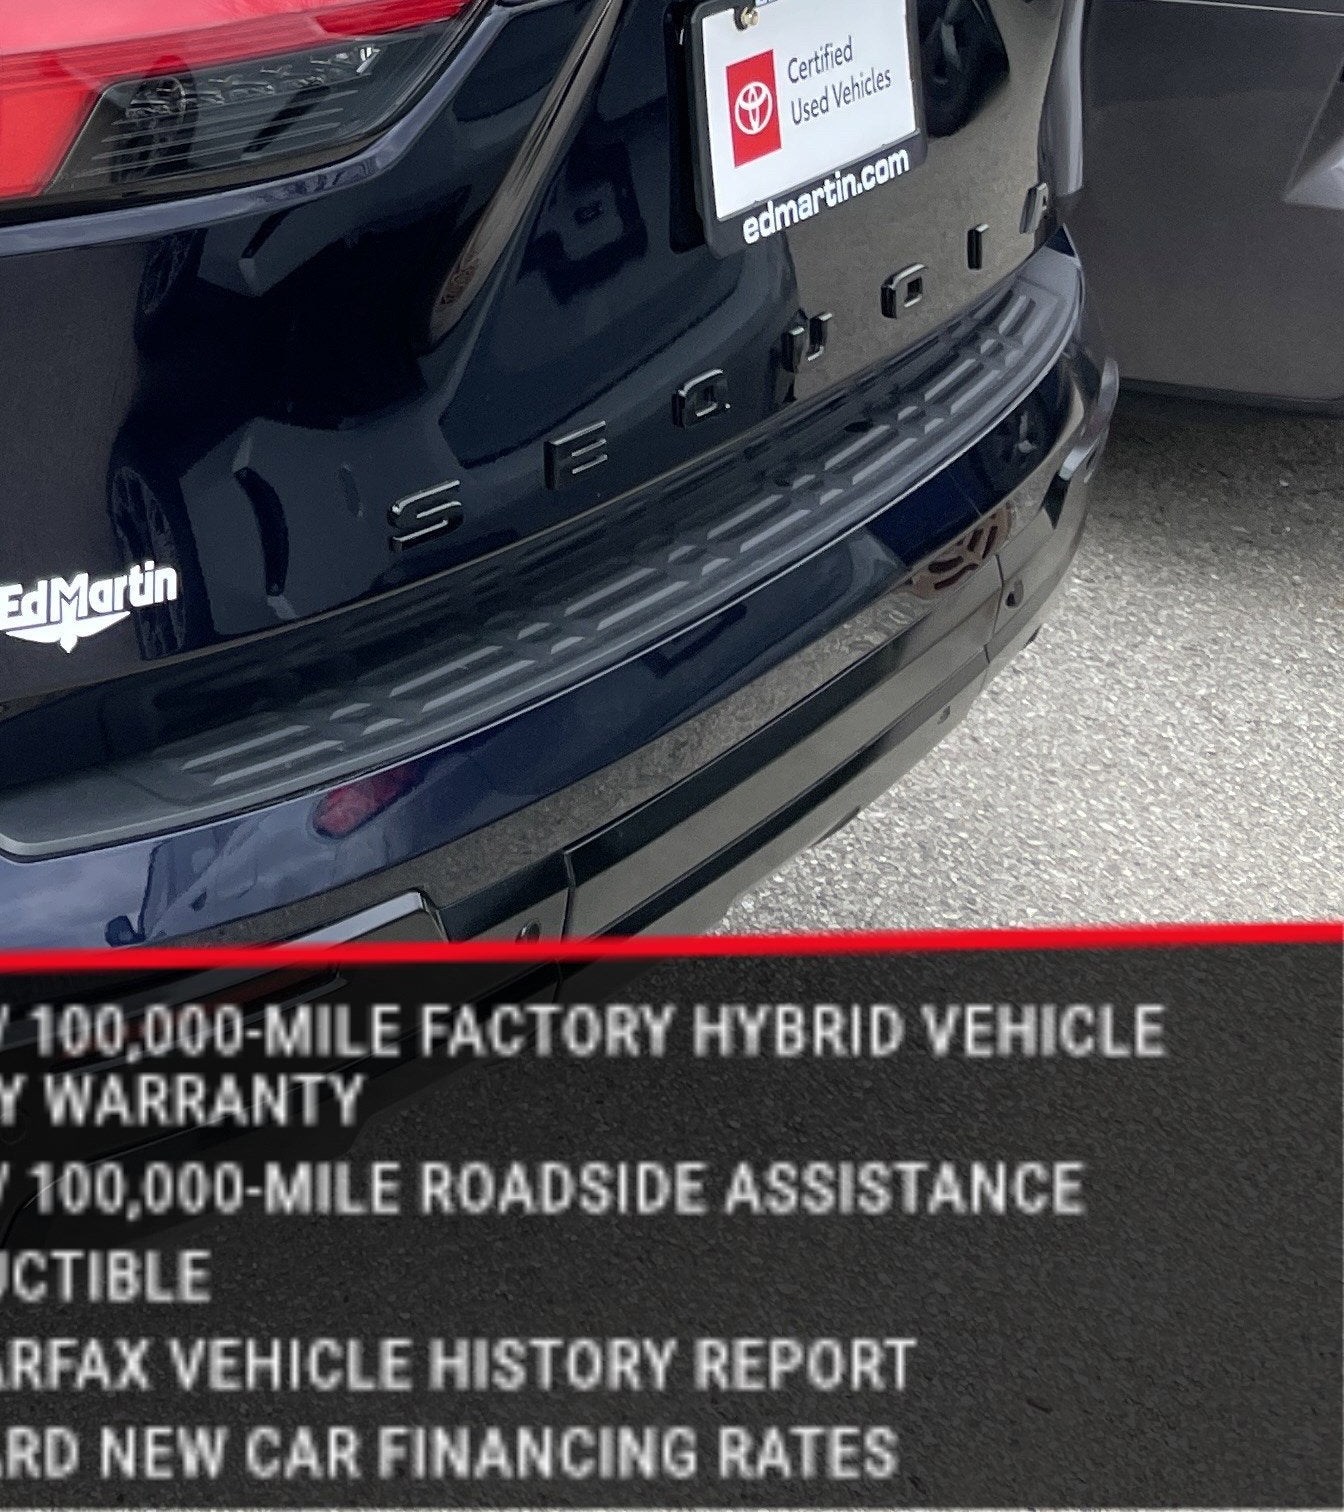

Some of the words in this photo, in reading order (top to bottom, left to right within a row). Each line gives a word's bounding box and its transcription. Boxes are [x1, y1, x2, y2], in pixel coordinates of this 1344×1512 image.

[787, 35, 853, 84] Certified
[790, 90, 829, 125] Used
[831, 67, 891, 110] Vehicles
[742, 148, 910, 245] edmartin.com
[386, 181, 1050, 552] SEQUOIA
